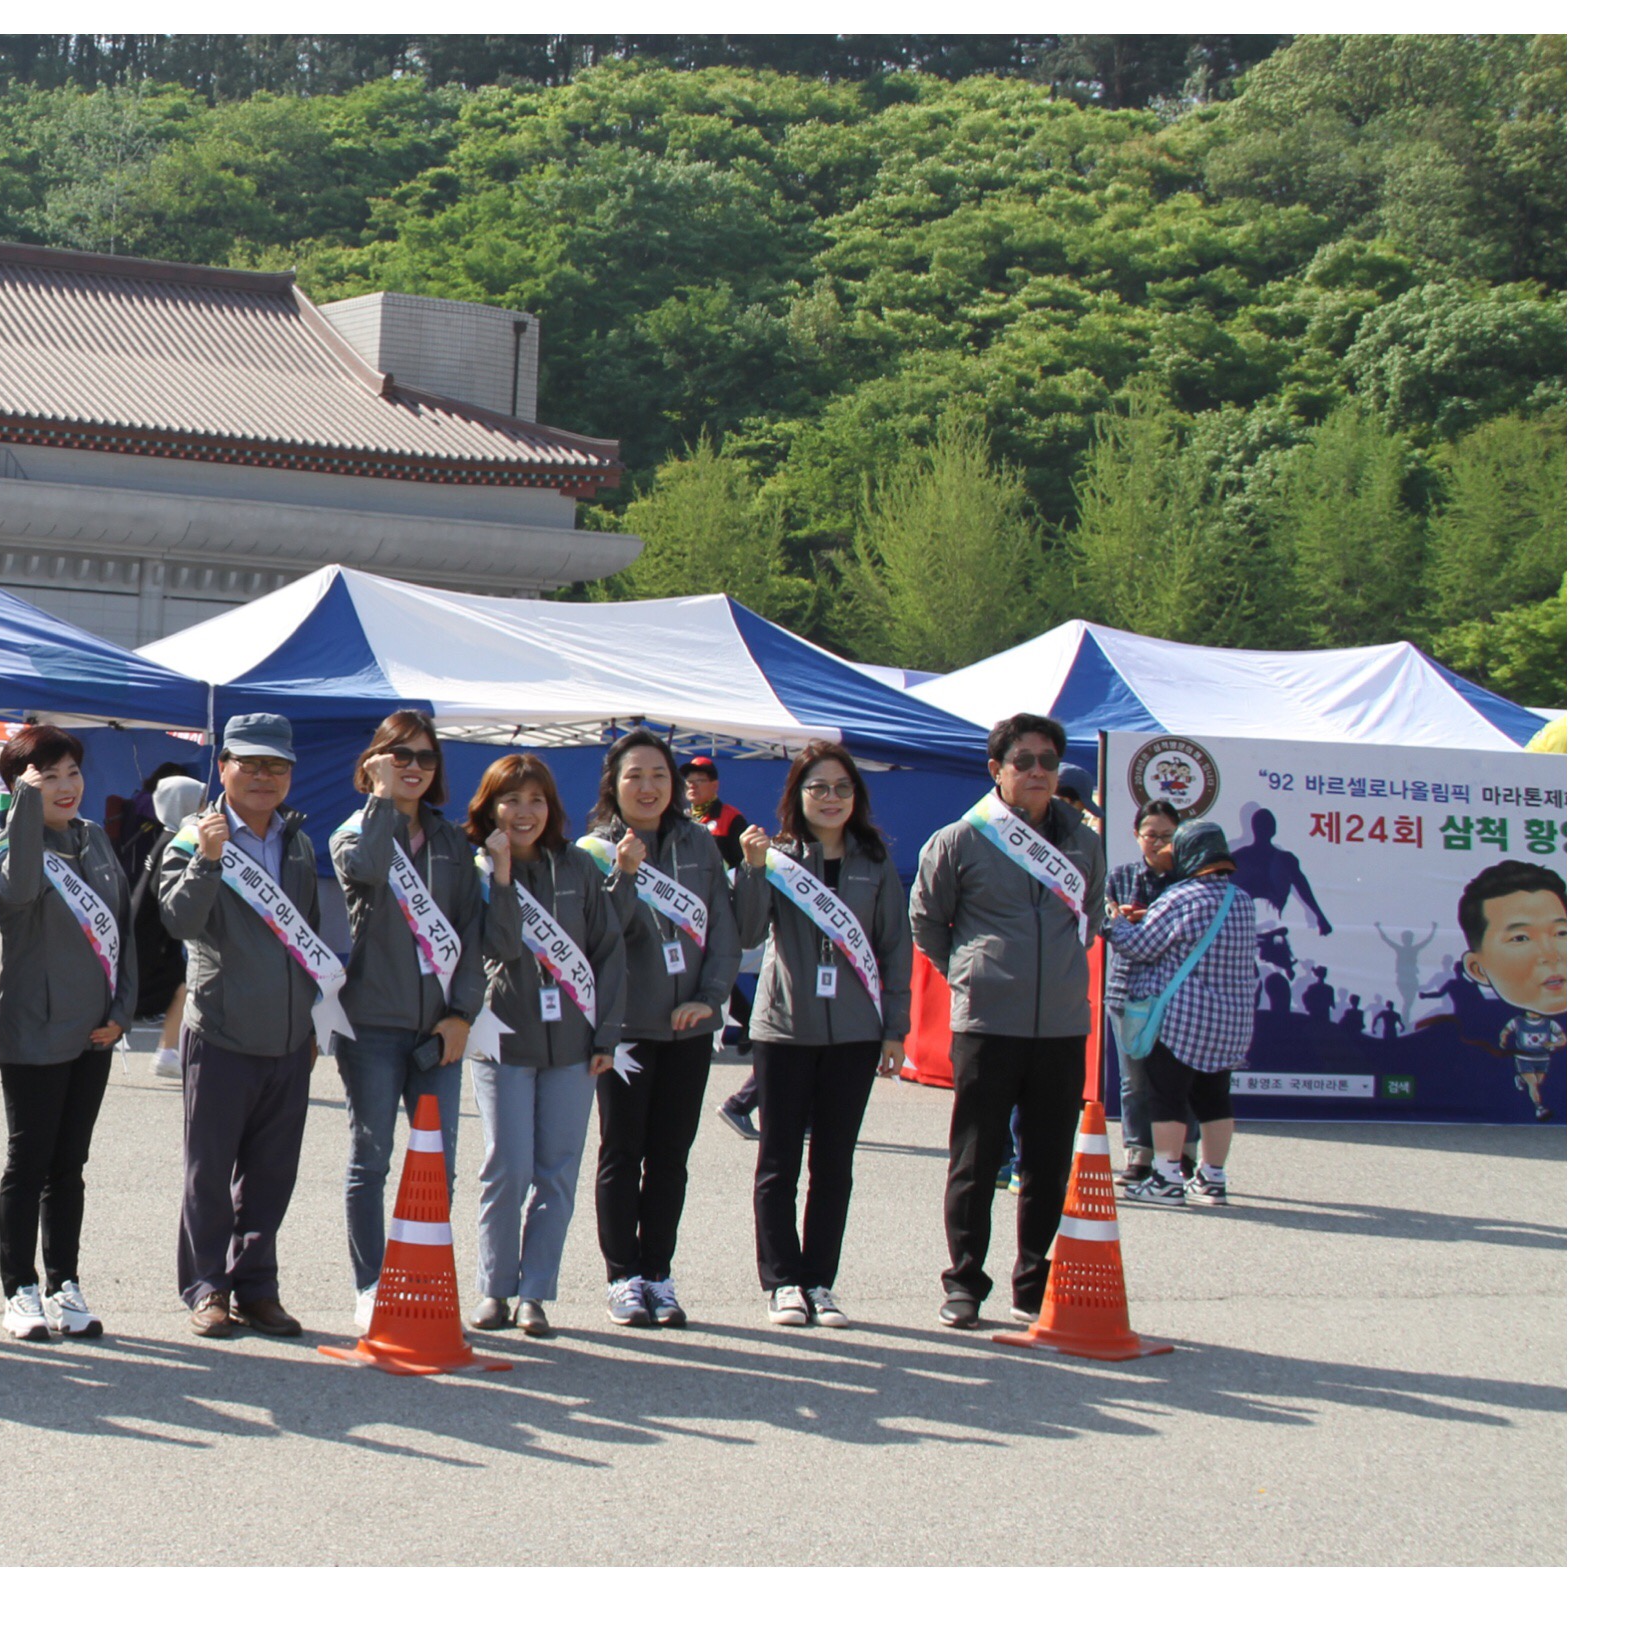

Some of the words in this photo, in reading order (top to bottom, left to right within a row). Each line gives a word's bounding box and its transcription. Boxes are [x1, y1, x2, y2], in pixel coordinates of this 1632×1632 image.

[1305, 774, 1471, 805] 바르셀로나올림픽
[1481, 785, 1567, 809] 마라톤제
[1009, 825, 1081, 894] 아름다운
[1309, 811, 1423, 849] 제24회
[1438, 815, 1509, 853] 삼척
[1524, 818, 1567, 855] 황
[46, 855, 112, 937] 아름다운
[221, 848, 296, 927] 아름다운
[295, 925, 332, 967] 선거
[796, 876, 864, 950] 아름다운
[428, 922, 460, 963] 선거
[1247, 1077, 1283, 1090] 황영조
[1289, 1078, 1349, 1091] 국제마라톤
